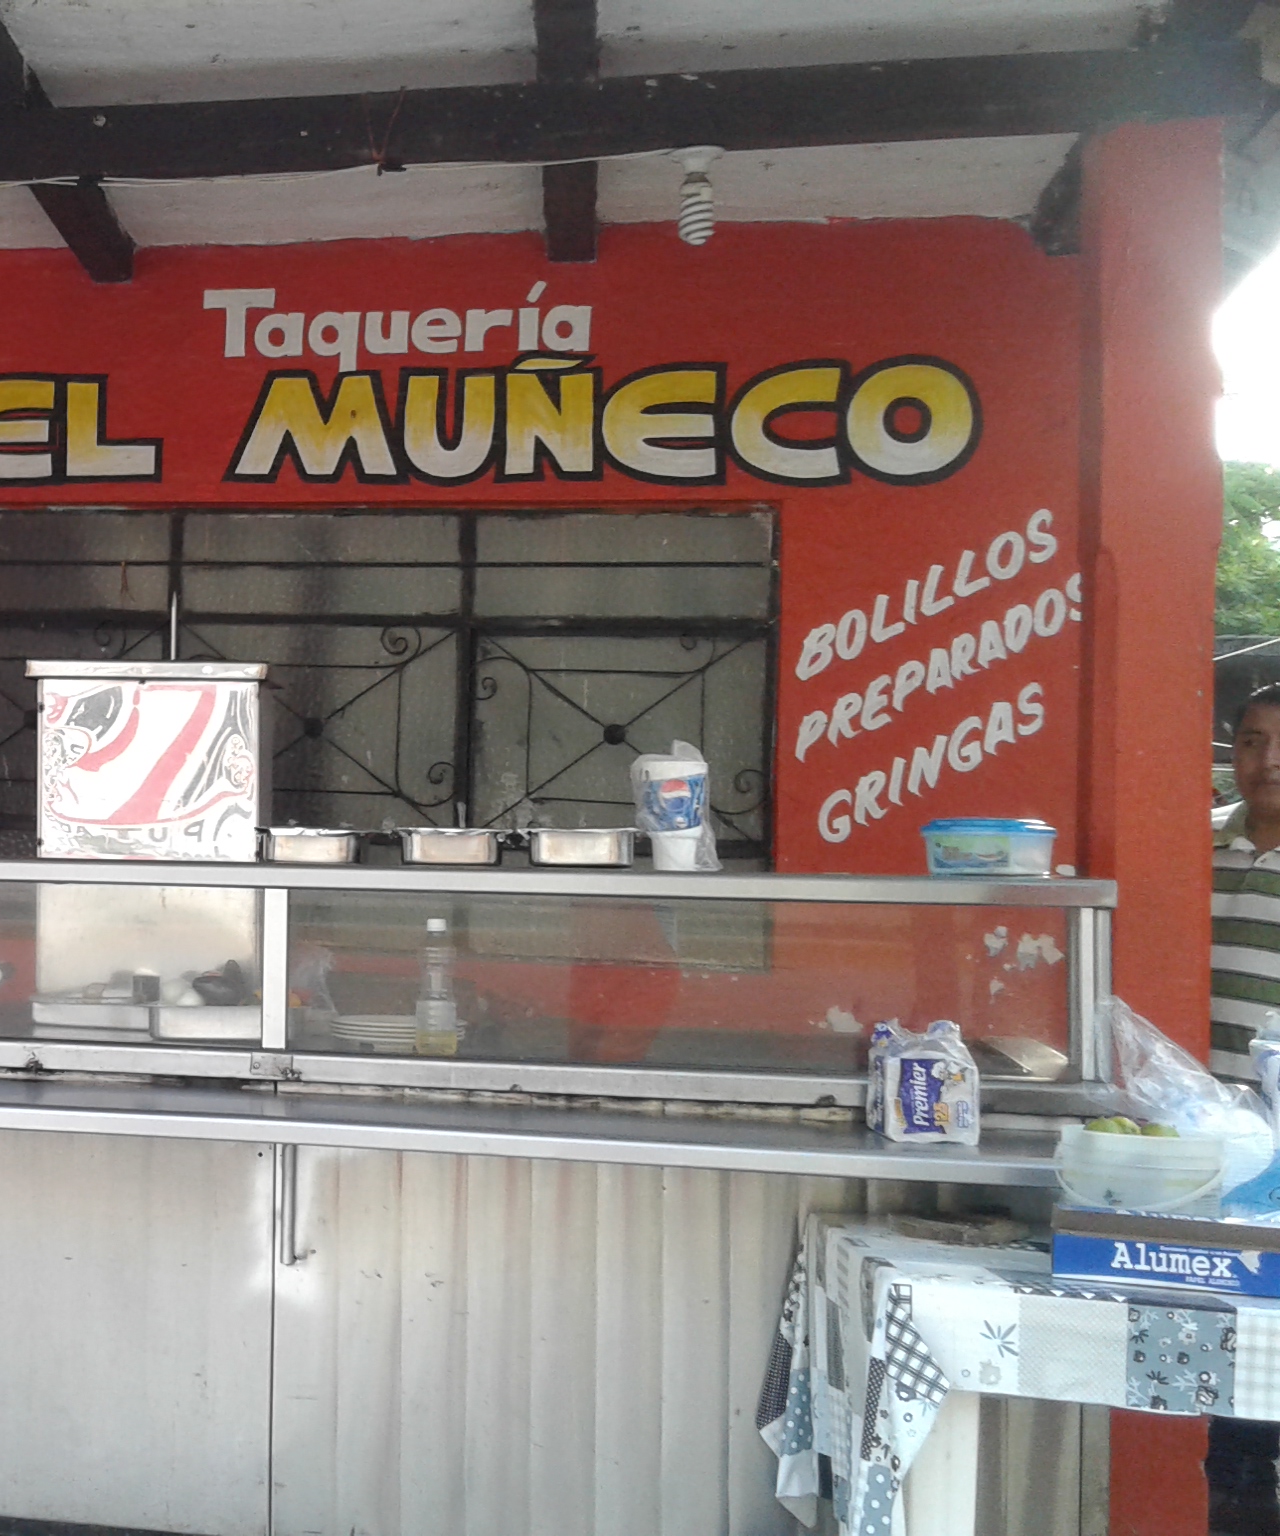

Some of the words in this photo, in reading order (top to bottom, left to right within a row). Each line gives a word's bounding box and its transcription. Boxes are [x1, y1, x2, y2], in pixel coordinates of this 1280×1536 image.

[203, 281, 593, 372] Taquería
[221, 350, 984, 486] MUÑECO
[795, 508, 1058, 681] BOLILLOS
[818, 682, 1045, 843] GRINGAS
[913, 1061, 931, 1127] Premier
[1110, 1242, 1234, 1279] Alumex
